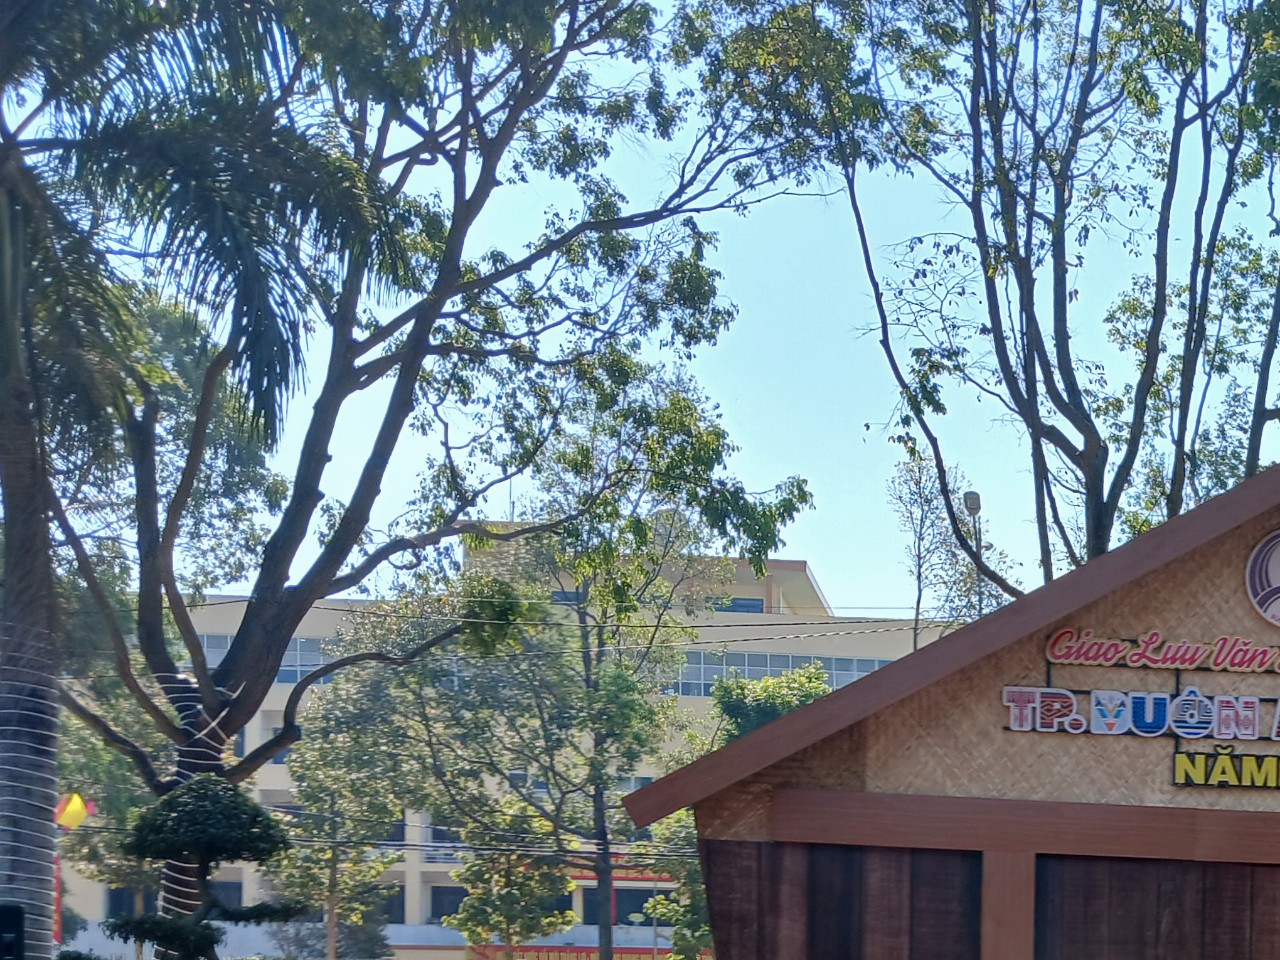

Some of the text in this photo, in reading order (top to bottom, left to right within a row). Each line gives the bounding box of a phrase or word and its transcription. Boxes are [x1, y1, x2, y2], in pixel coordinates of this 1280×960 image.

[1048, 629, 1127, 664] Giao
[1129, 631, 1207, 666] Lưu
[1212, 636, 1275, 669] Văn
[1174, 745, 1279, 788] NĂM
